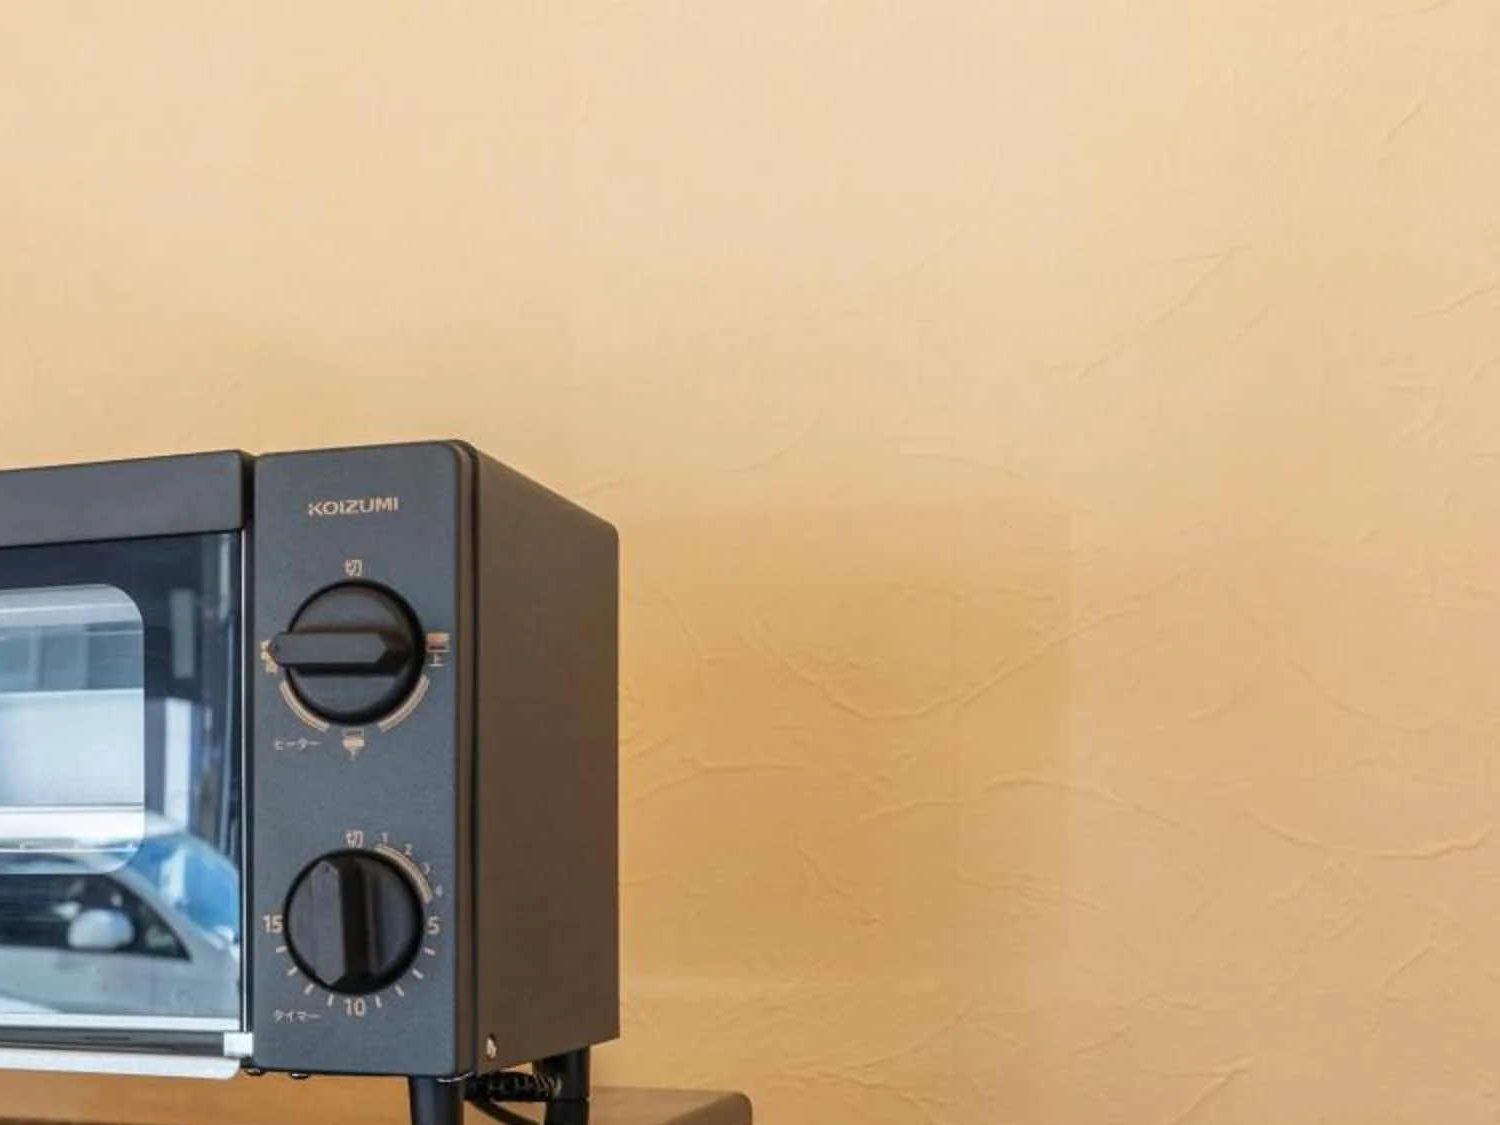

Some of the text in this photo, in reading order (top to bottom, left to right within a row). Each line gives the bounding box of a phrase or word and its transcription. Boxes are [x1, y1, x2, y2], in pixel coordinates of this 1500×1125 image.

[308, 496, 399, 516] KOIZUMI
[344, 558, 363, 577] 切
[273, 737, 321, 751] ヒーター
[263, 914, 284, 933] 15
[427, 916, 440, 934] 5
[273, 1009, 321, 1022] タイマー
[345, 997, 366, 1016] 10
